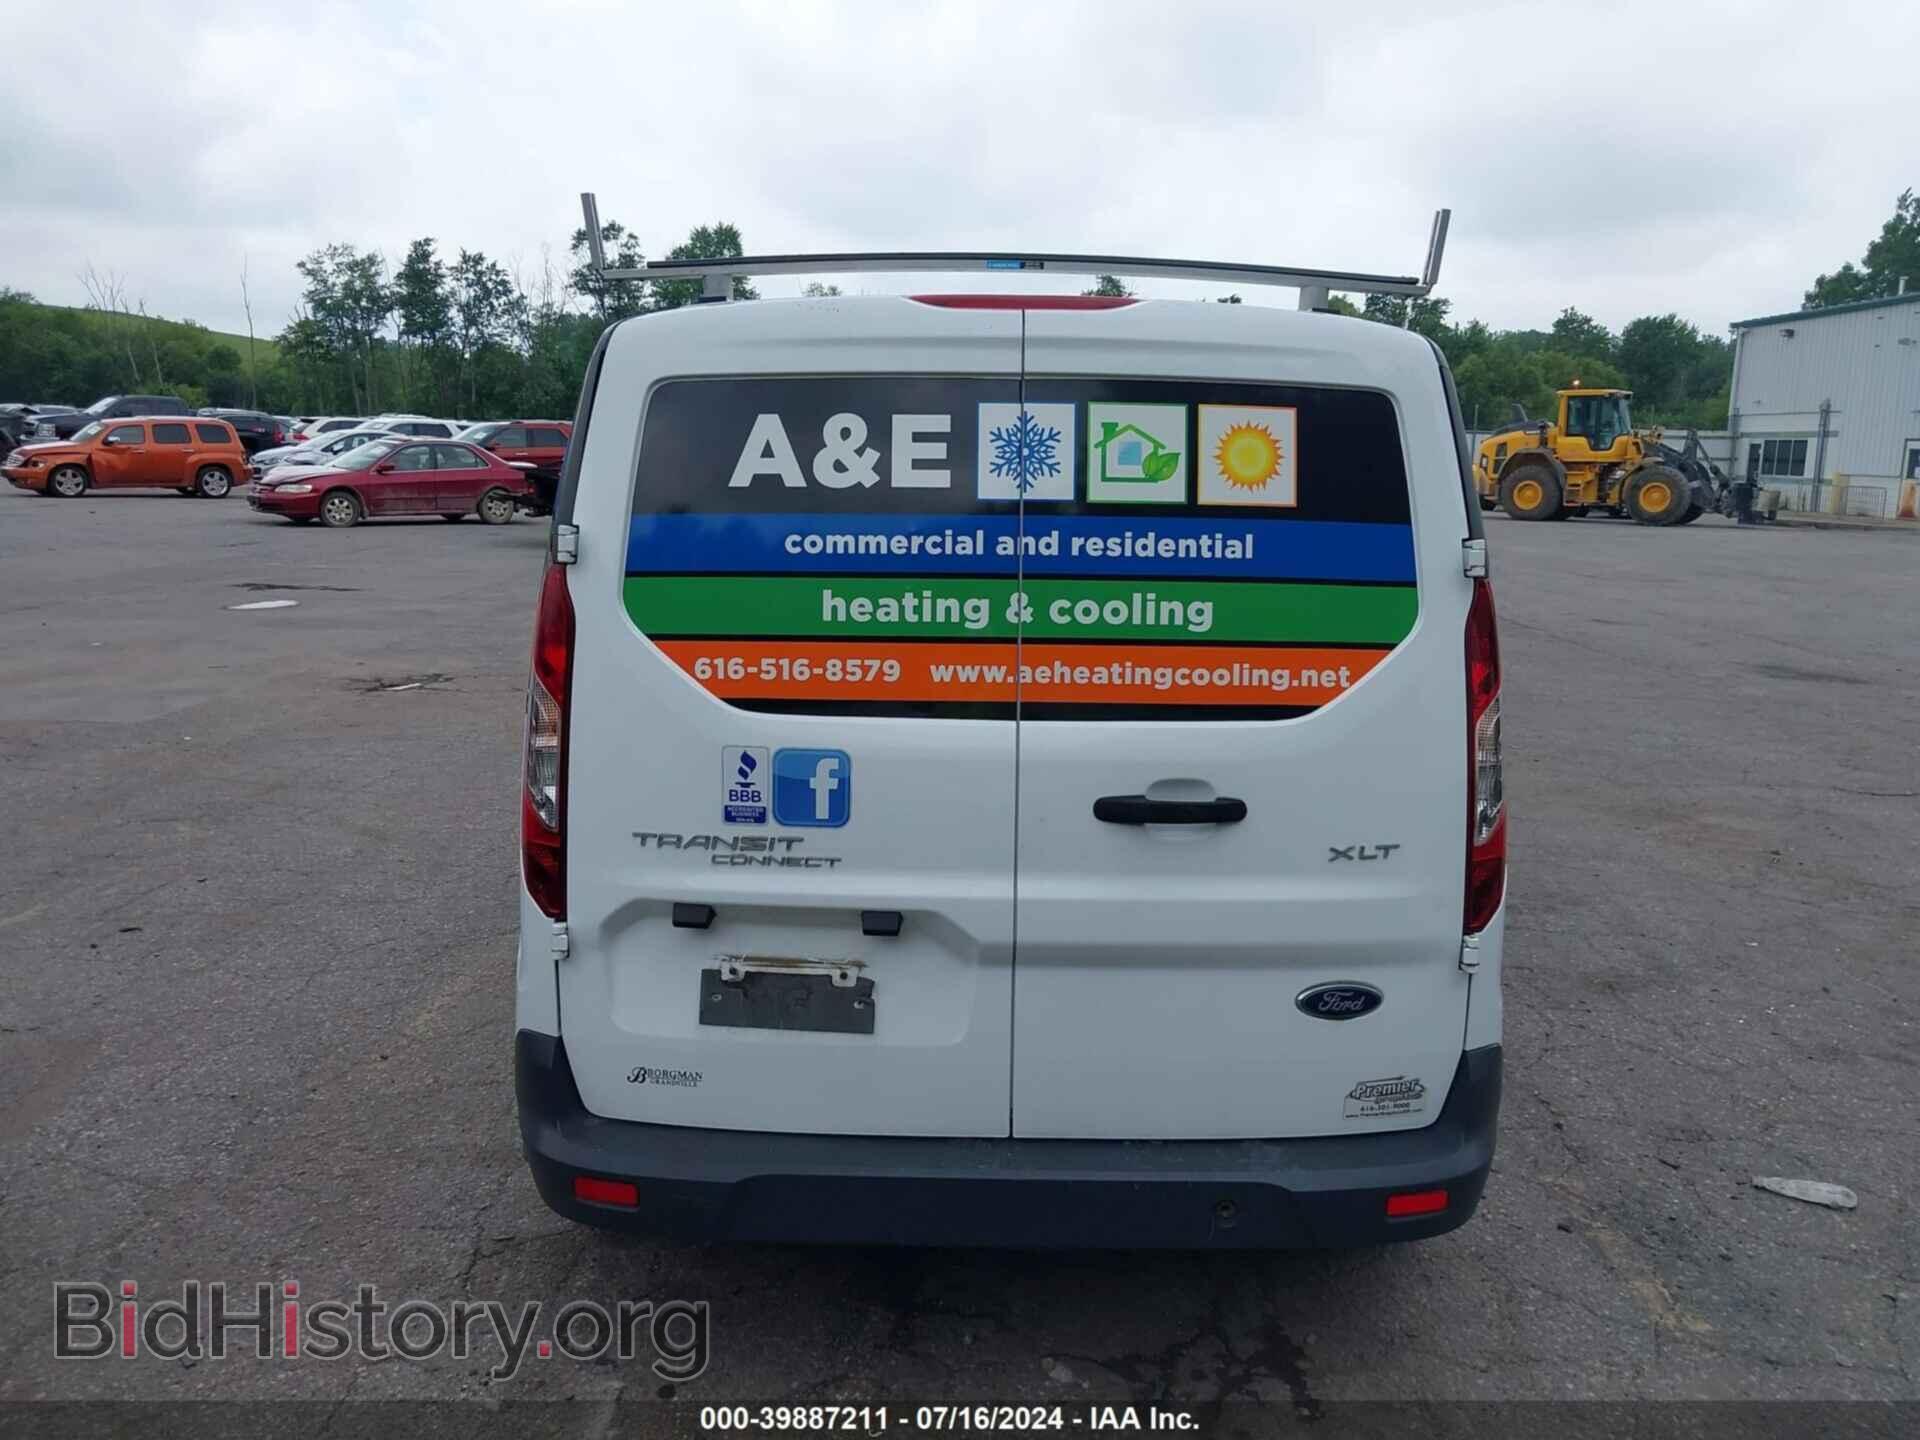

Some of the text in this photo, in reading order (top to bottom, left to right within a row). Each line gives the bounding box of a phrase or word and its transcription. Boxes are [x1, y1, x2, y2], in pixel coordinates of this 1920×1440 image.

[728, 412, 953, 490] A&E
[784, 529, 1254, 560] commercial and residential
[822, 589, 1214, 633] heating & cooling
[693, 656, 1351, 691] 616-516-8579 www.aeheatingcooling.net
[728, 789, 762, 803] BBB
[631, 832, 805, 852] TRANSIT
[711, 853, 843, 868] CONNECT
[1327, 844, 1401, 862] XLT
[1318, 991, 1366, 1011] Ford
[1356, 1079, 1420, 1100] Premier
